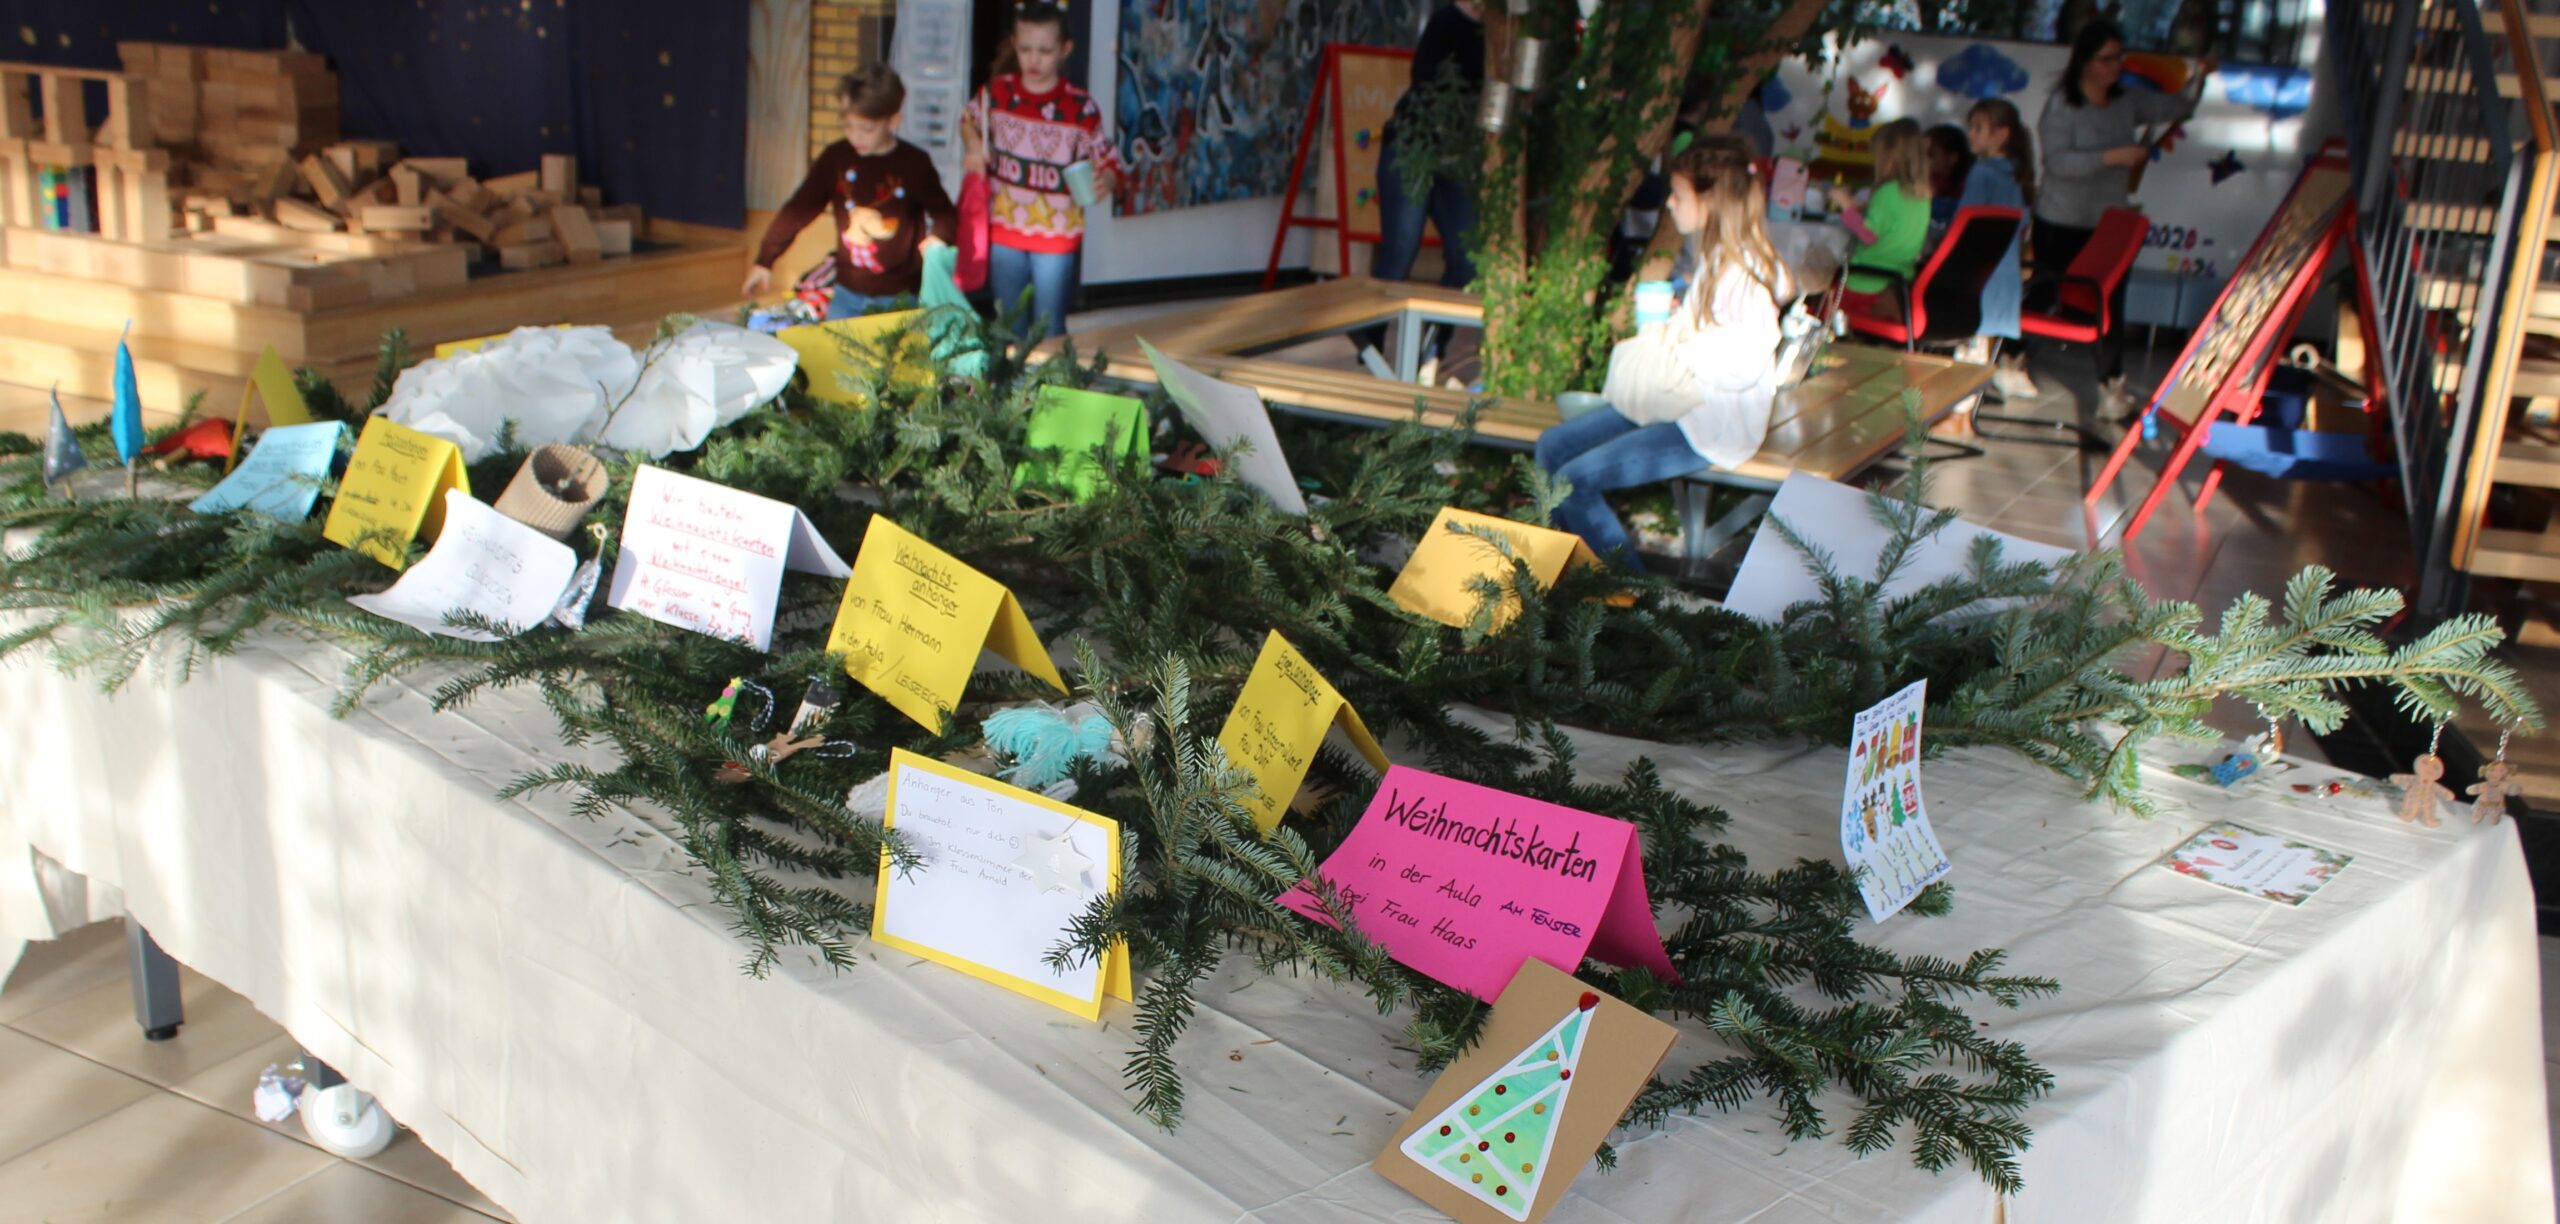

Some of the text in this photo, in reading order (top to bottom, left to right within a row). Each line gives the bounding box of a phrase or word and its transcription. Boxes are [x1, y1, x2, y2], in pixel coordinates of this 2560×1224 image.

[1028, 162, 1060, 190] HO
[2144, 224, 2198, 251] 2020
[662, 482, 683, 504] Wir
[651, 504, 775, 556] Weihnachtskarten
[672, 540, 731, 564] mit einem
[894, 541, 959, 590] Weihnachts-
[650, 549, 748, 596] Weihnachtsengel
[638, 598, 656, 609] vor
[664, 601, 700, 623] Klasse
[850, 594, 942, 654] von Frau Hermann
[846, 630, 861, 649] der
[863, 638, 885, 663] Aula
[1253, 710, 1265, 735] Frau
[1238, 732, 1251, 755] Frau
[960, 795, 976, 807] aus
[985, 797, 1004, 817] Ton
[900, 803, 912, 817] Du
[965, 827, 981, 837] nur
[987, 830, 1005, 843] dich
[1384, 788, 1598, 883] Weihnachtskarten
[928, 836, 942, 848] Im
[947, 842, 1014, 874] Klassenzimmer
[1018, 869, 1034, 881] der
[949, 859, 969, 874] Frau
[977, 868, 1008, 887] Arnold
[1368, 852, 1387, 871] in
[1400, 863, 1432, 884] der
[1436, 878, 1483, 908] Aula
[1530, 908, 1581, 938] FENSTER
[1340, 884, 1477, 951] bei Frau Haas
